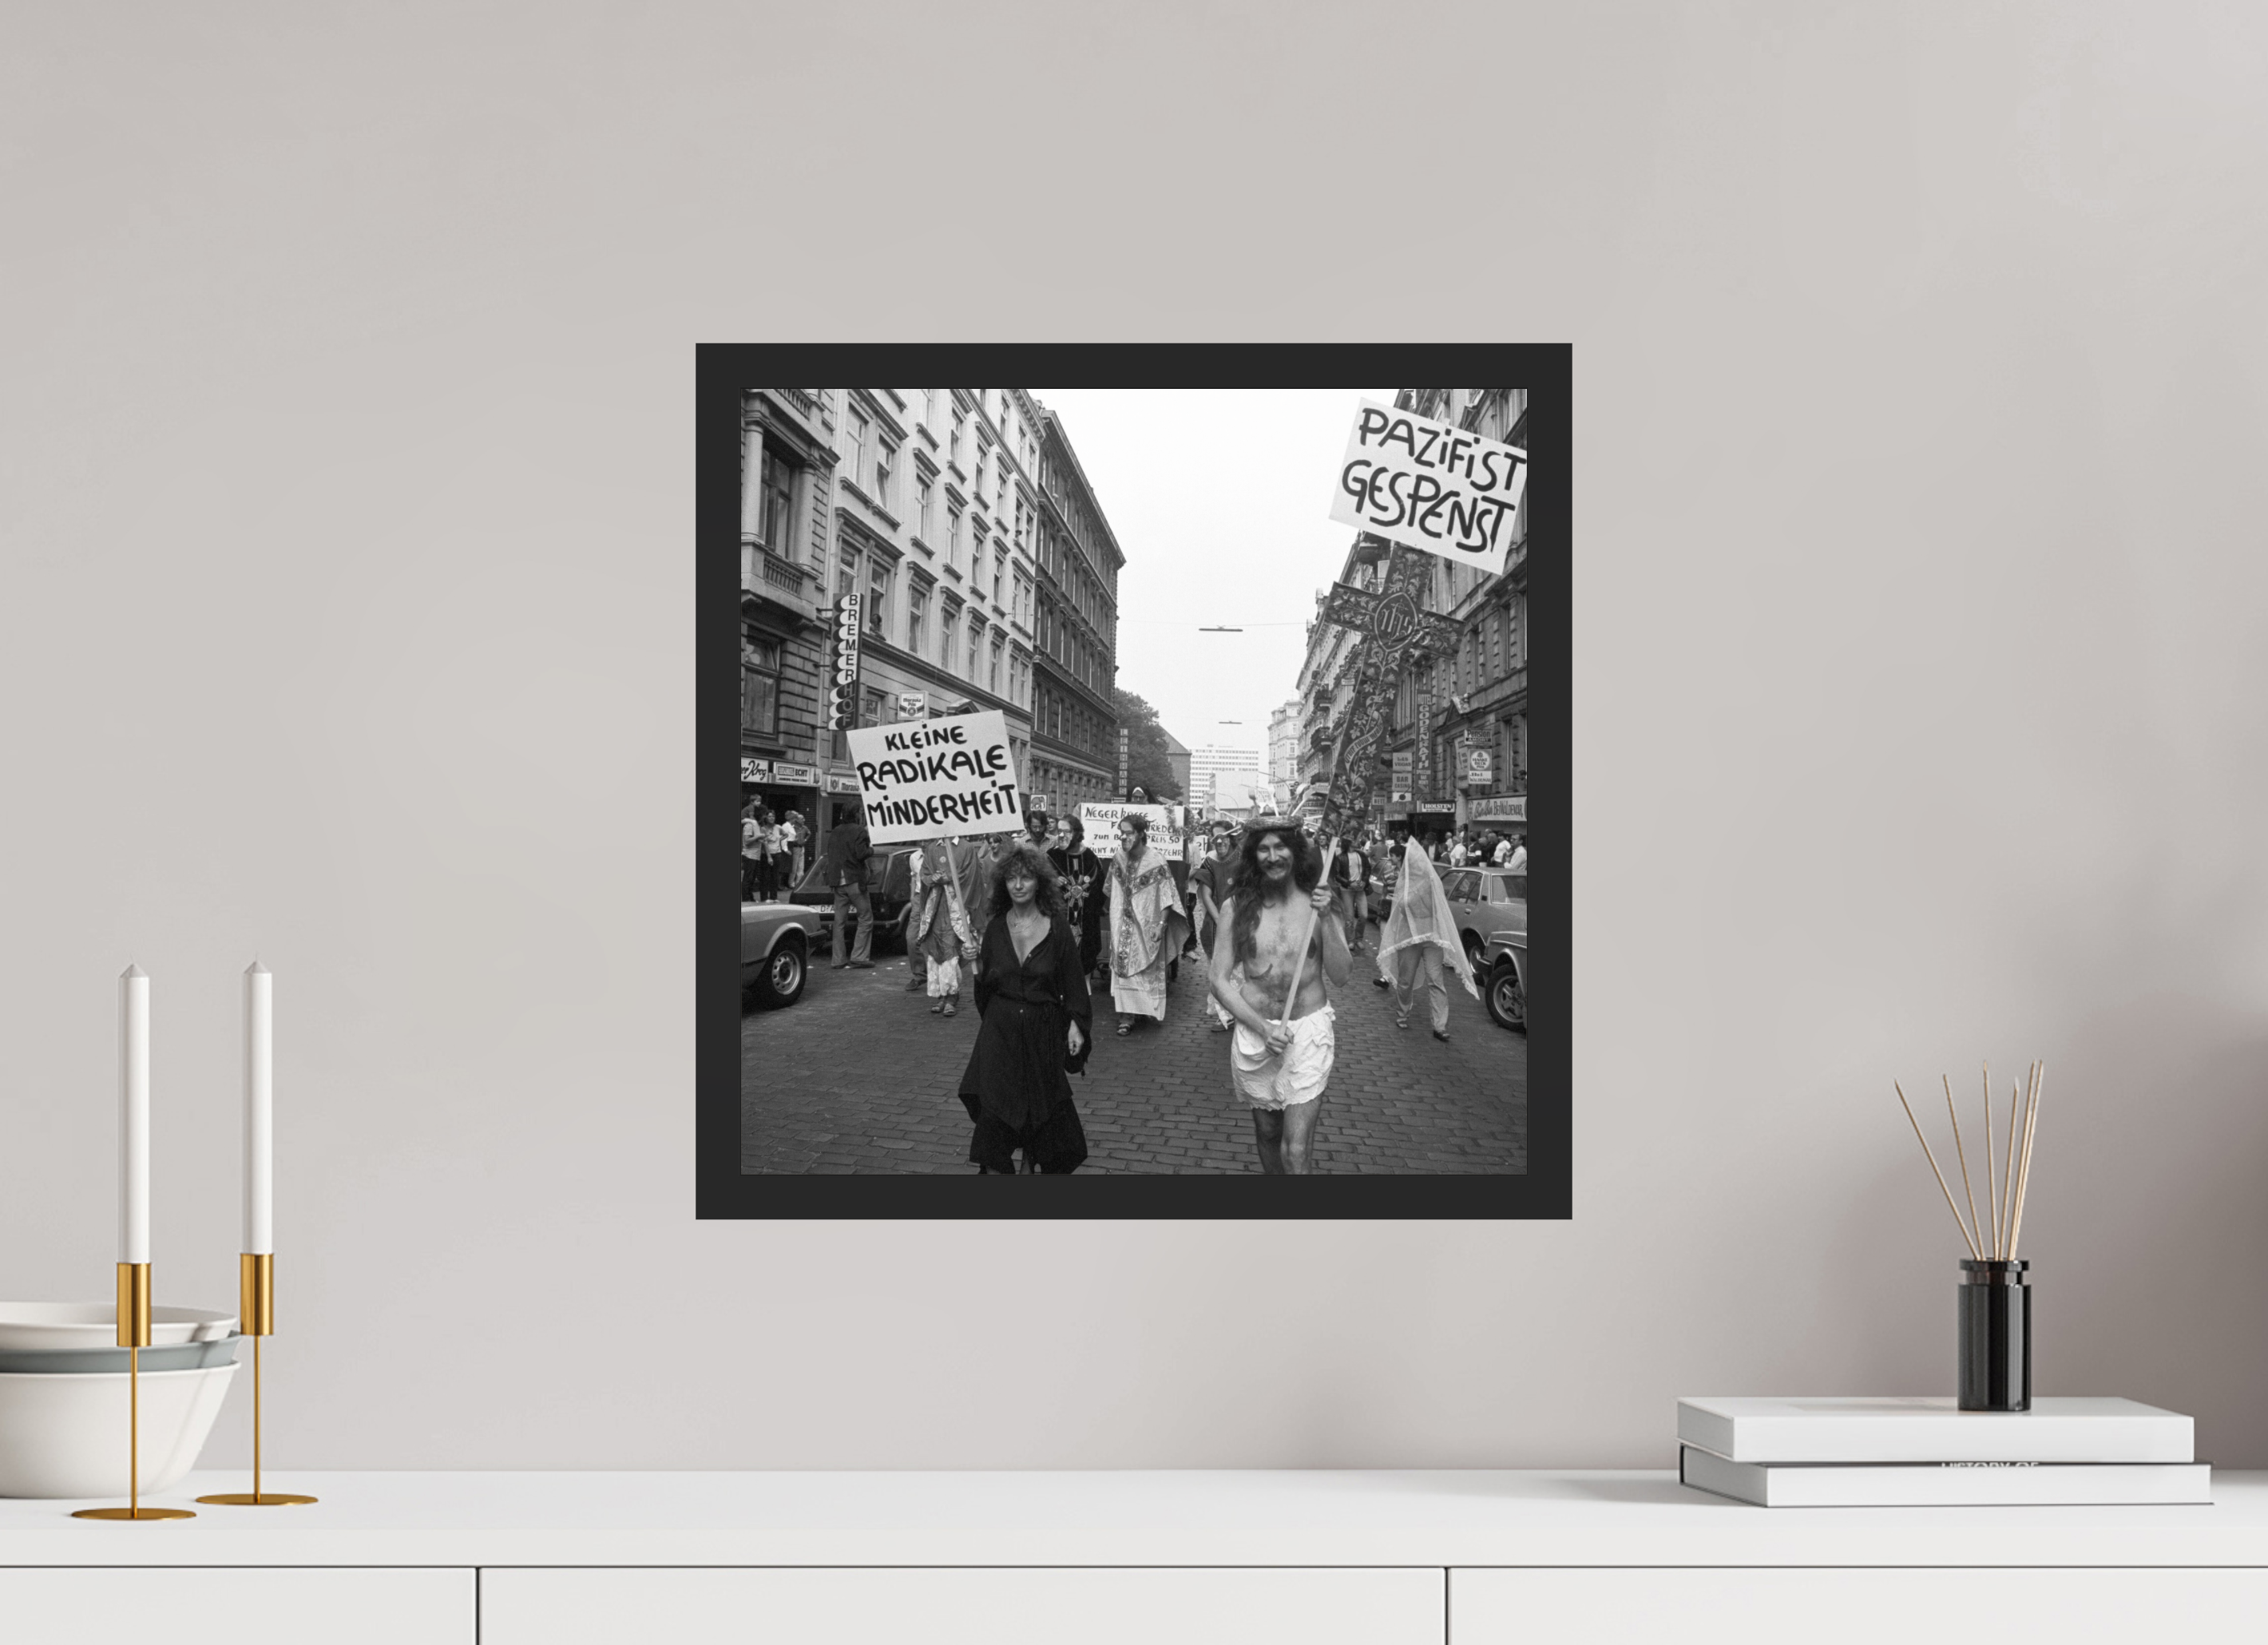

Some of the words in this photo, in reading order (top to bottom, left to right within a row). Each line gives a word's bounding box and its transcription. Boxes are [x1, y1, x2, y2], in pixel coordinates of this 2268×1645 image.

[1342, 458, 1515, 553] GESPENST
[1120, 729, 1128, 795] LEIHHAUS
[1418, 704, 1429, 769] GODENRATH
[1467, 729, 1490, 738] Pension
